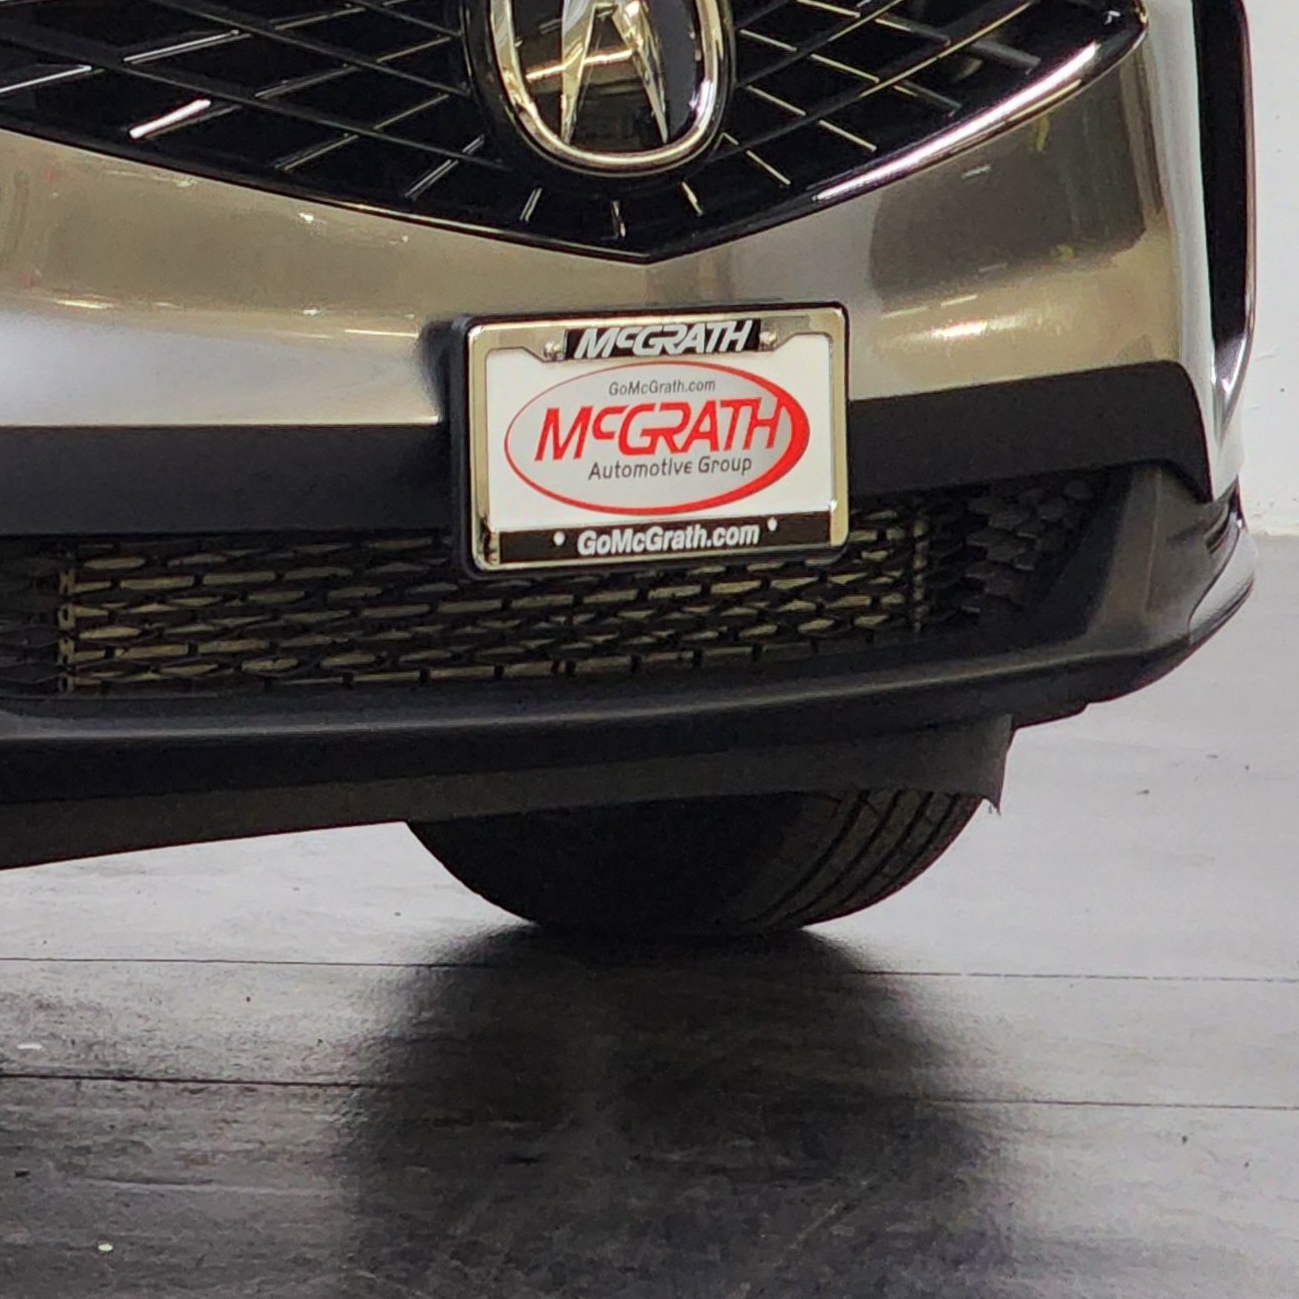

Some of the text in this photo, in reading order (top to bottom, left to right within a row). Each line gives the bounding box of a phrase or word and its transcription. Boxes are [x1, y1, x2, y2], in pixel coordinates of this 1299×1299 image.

[608, 378, 716, 397] GoMcGrath.com
[588, 456, 752, 481] Automotive Group
[576, 523, 760, 556] GoMcGrath.com
